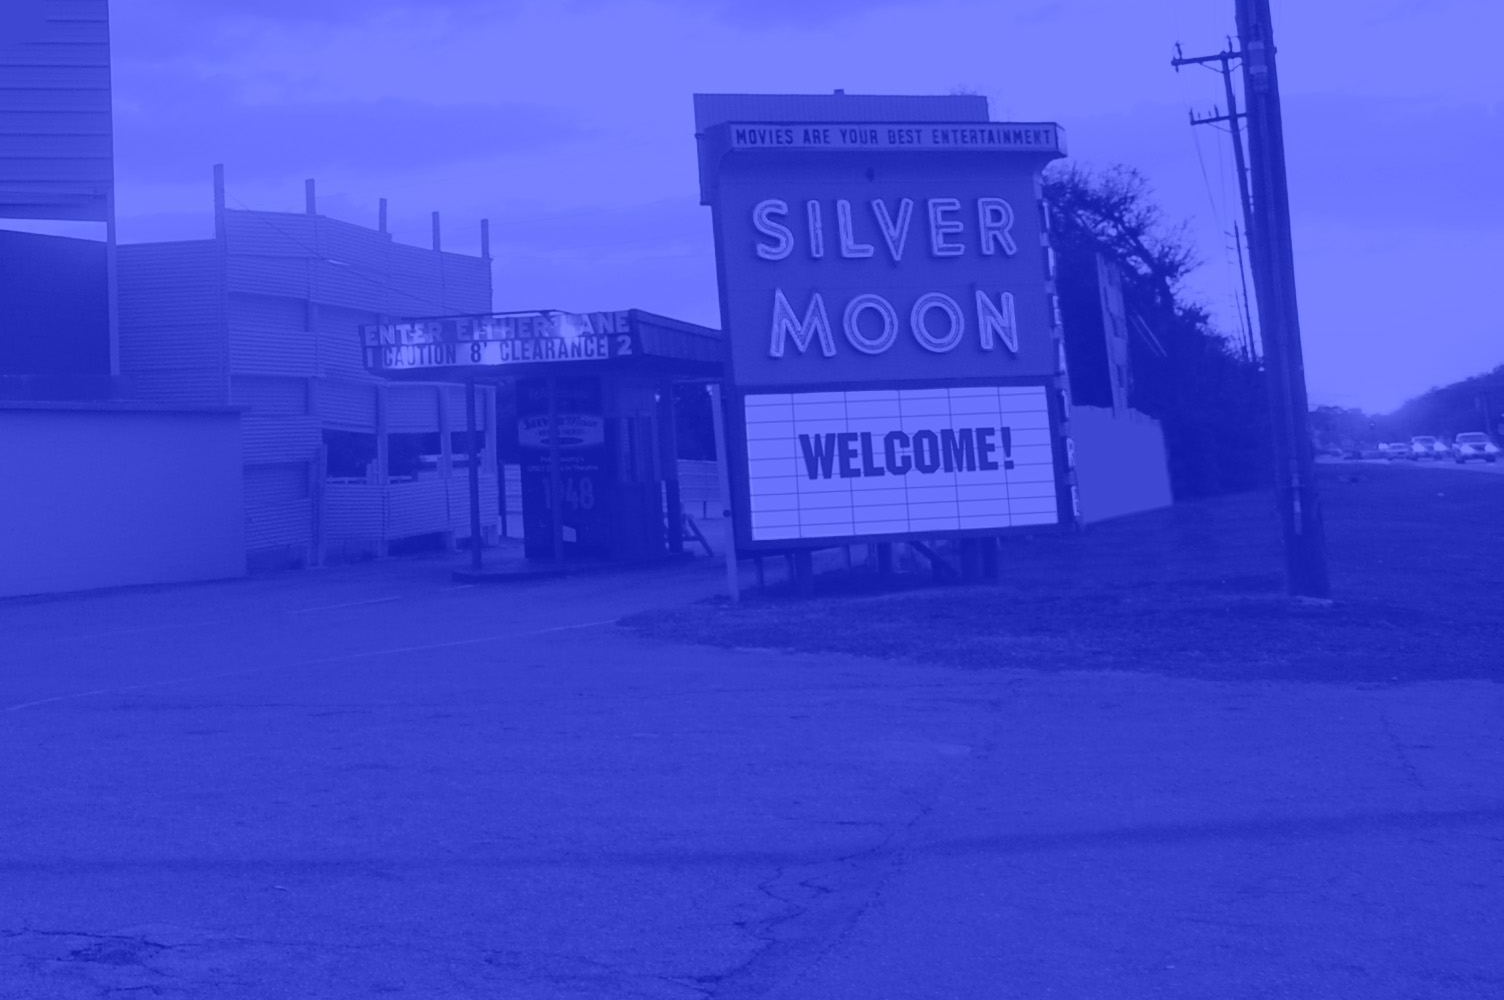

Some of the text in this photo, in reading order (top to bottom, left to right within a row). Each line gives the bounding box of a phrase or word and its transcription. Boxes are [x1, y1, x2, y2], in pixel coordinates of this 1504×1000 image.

[735, 128, 1052, 146] MOVIES ARE YOUR BEST ENTERTAINMENT
[752, 197, 1018, 262] SILVER
[364, 322, 444, 346] ENTER
[766, 287, 1020, 359] MOON
[383, 343, 457, 367] CAUTION
[499, 335, 607, 361] CLEARANCE
[616, 334, 633, 356] 2
[799, 427, 1015, 480] WELCOME!
